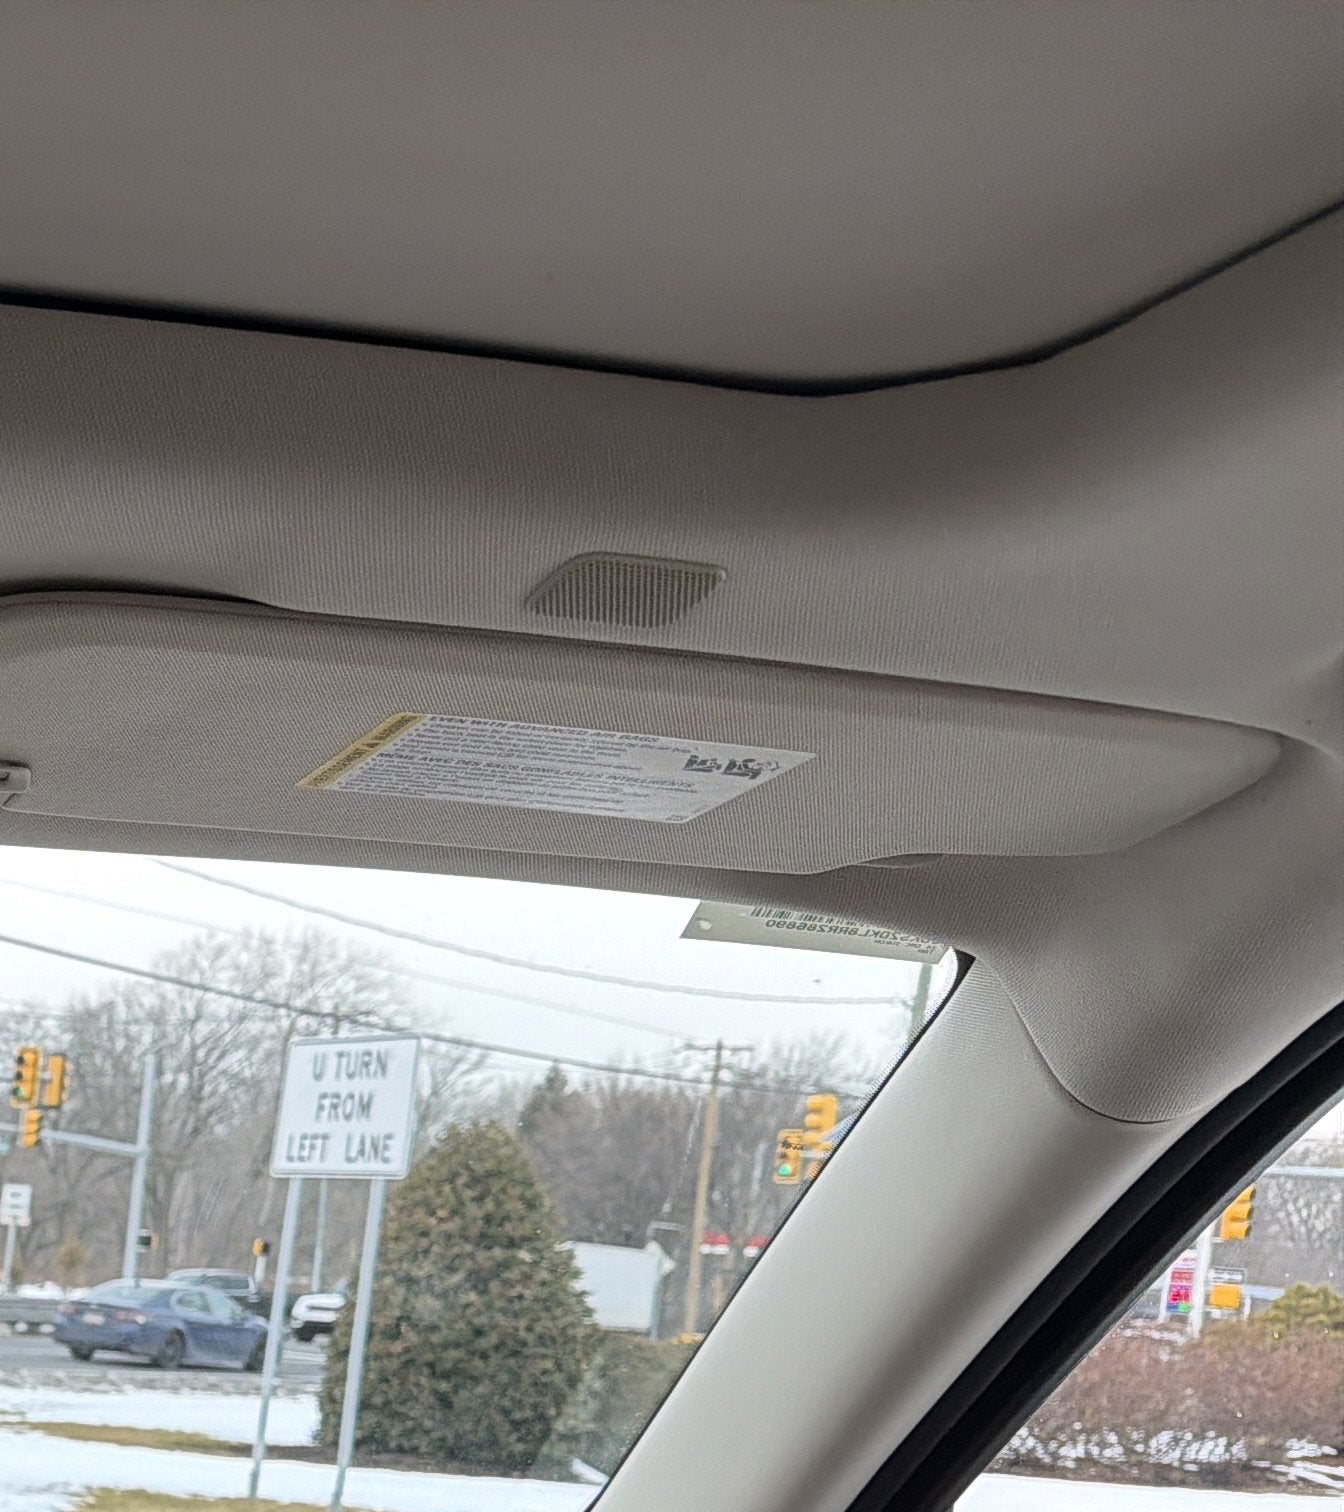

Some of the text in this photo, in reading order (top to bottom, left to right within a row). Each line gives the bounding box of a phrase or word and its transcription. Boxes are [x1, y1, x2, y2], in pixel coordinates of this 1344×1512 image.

[312, 1050, 389, 1081] U TURN
[315, 1091, 374, 1122] FROM
[286, 1132, 394, 1164] LEFT LANE
